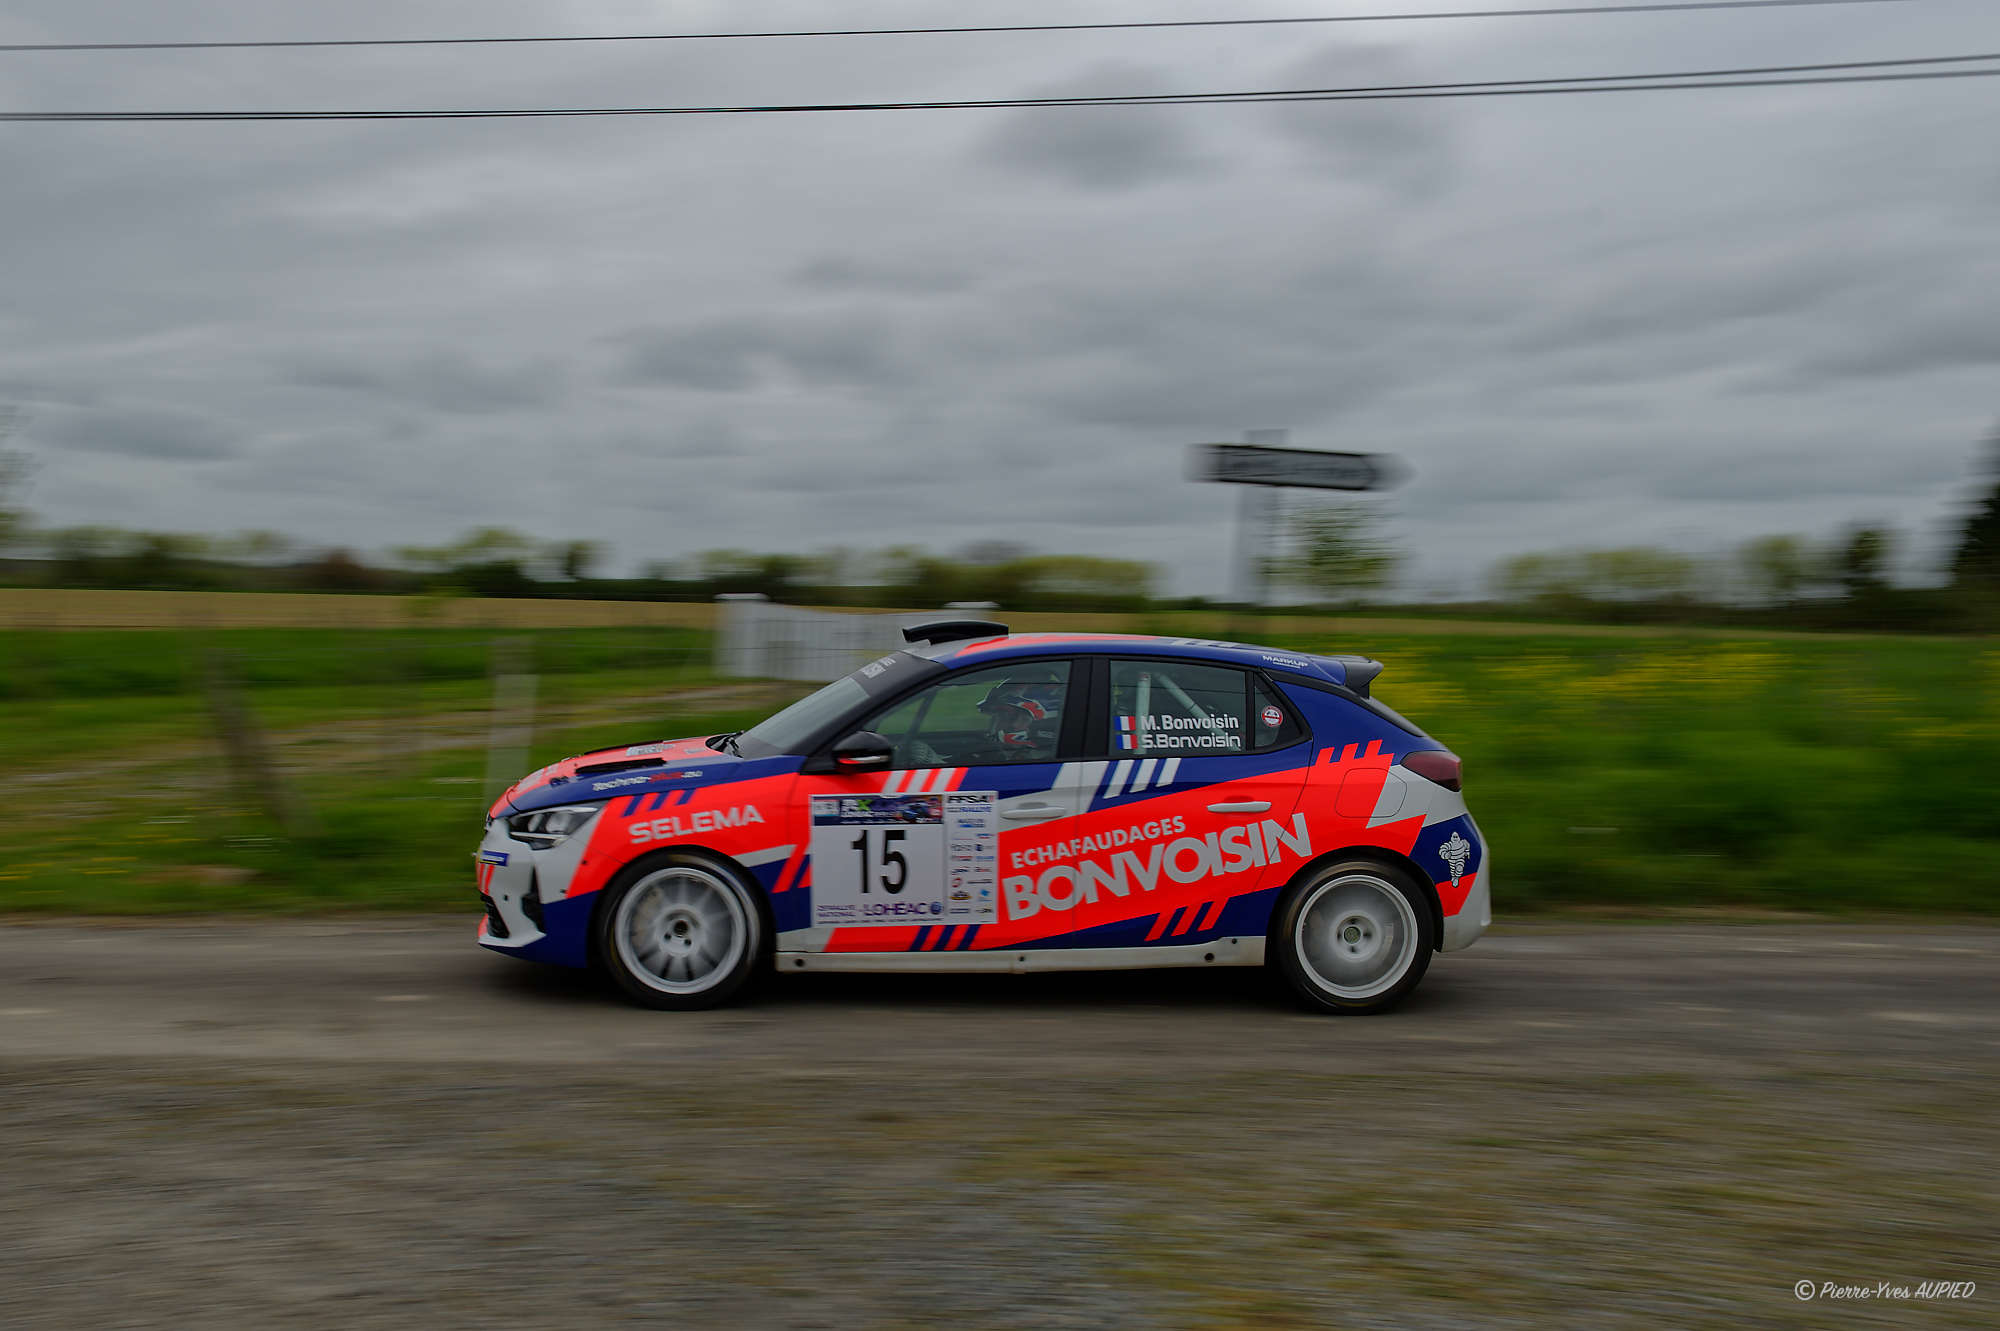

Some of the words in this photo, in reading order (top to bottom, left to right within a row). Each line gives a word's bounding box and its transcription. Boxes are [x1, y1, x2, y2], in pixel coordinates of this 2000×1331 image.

[1262, 655, 1308, 667] MARKUP
[1141, 715, 1160, 730] M.
[1162, 713, 1239, 731] Bonvoisin
[628, 804, 765, 844] SELEMA
[1010, 815, 1187, 869] ECHAFAUDAGES
[852, 829, 908, 894] 15
[1002, 812, 1312, 921] BONVOISIN
